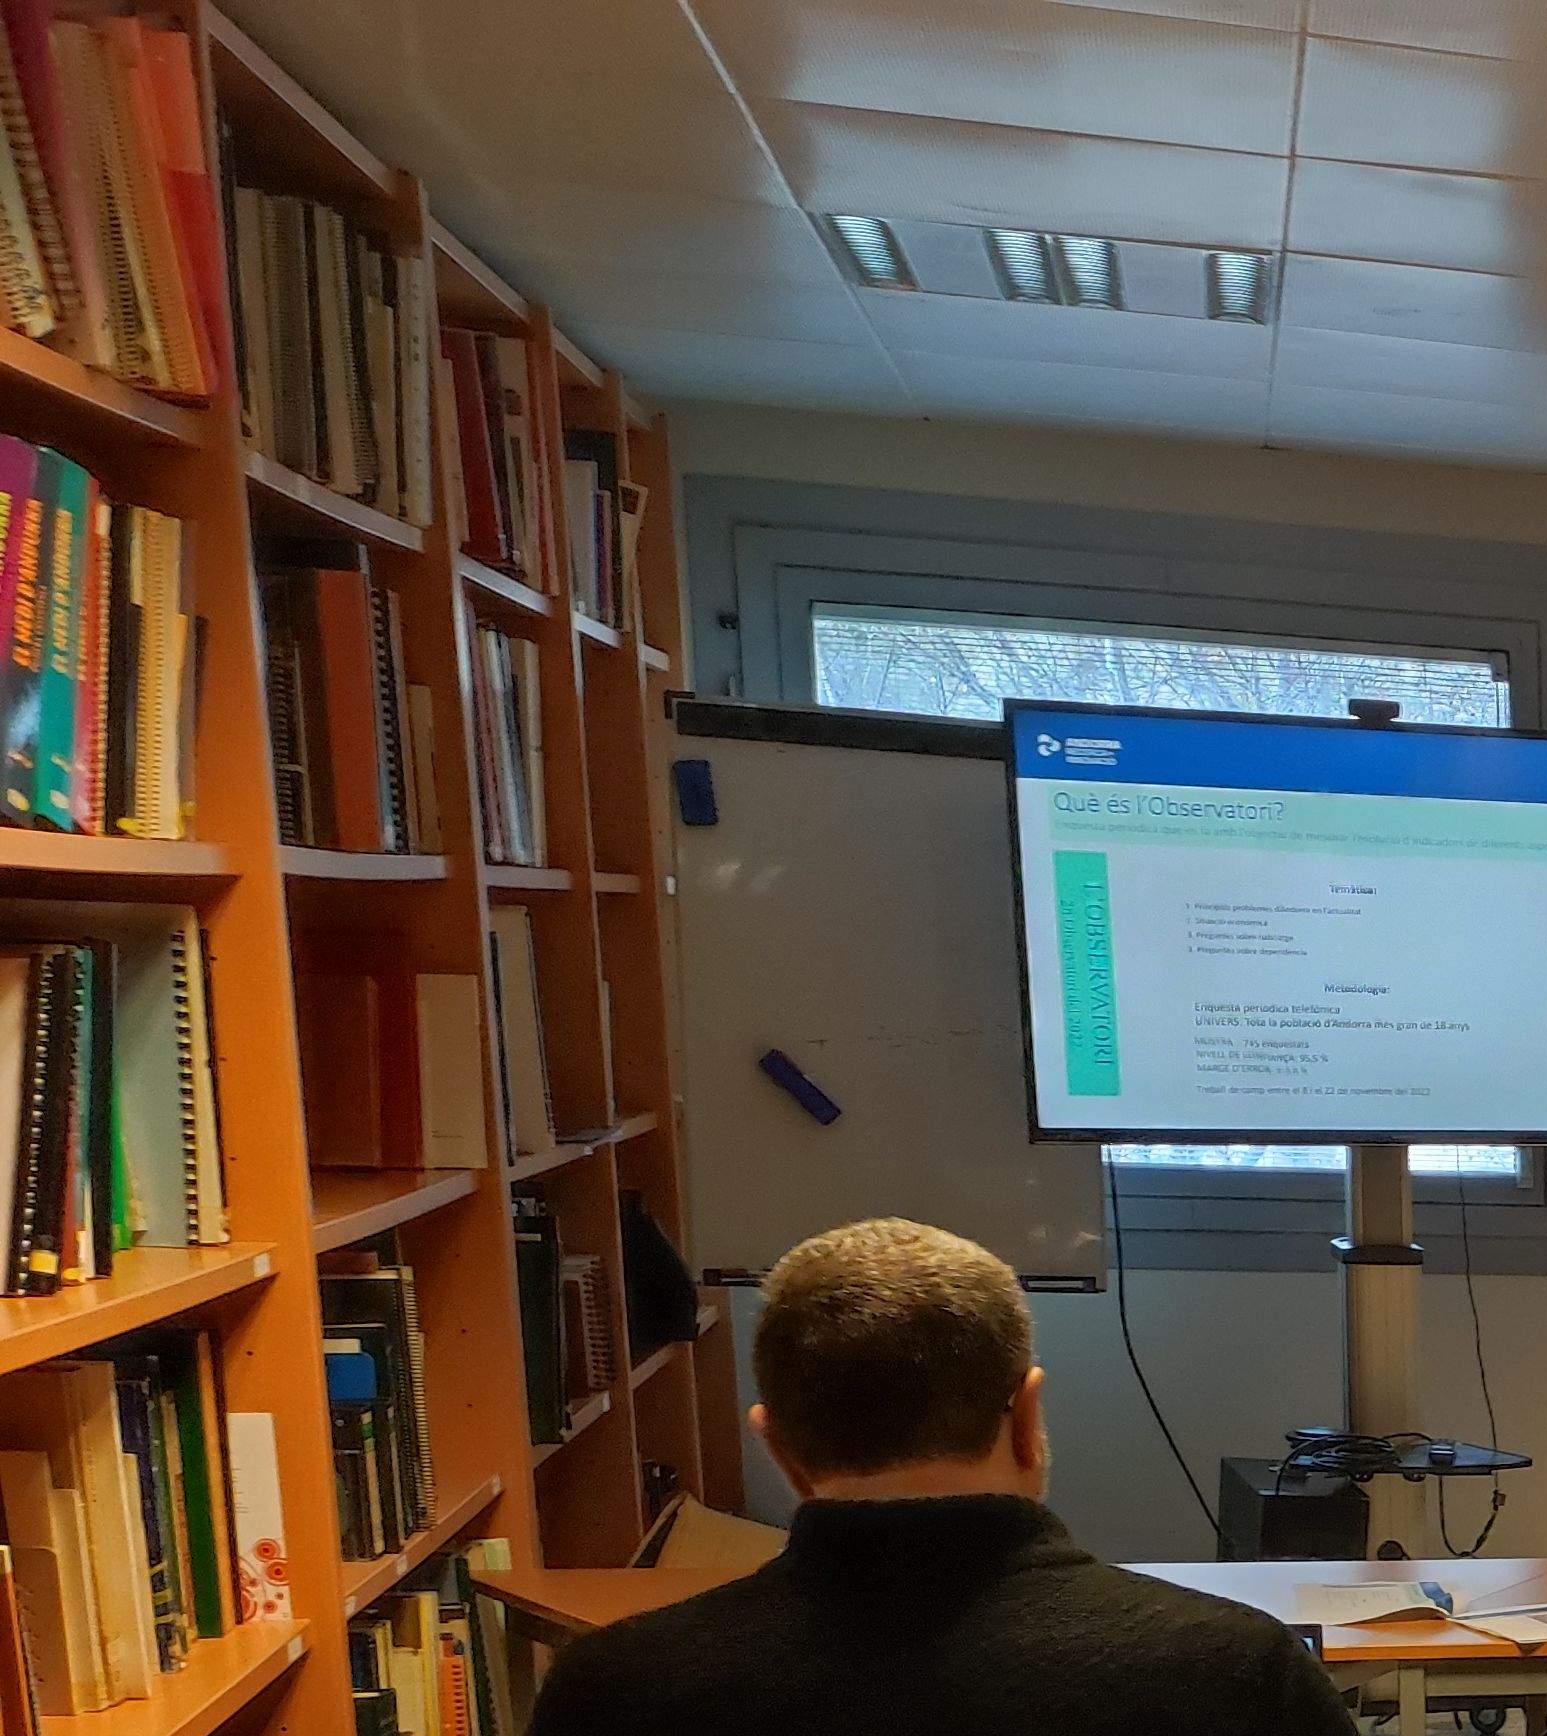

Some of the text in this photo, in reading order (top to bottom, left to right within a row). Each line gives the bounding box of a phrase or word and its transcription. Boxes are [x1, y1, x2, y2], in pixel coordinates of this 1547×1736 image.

[1053, 791, 1284, 821] Què és l'Observatori?
